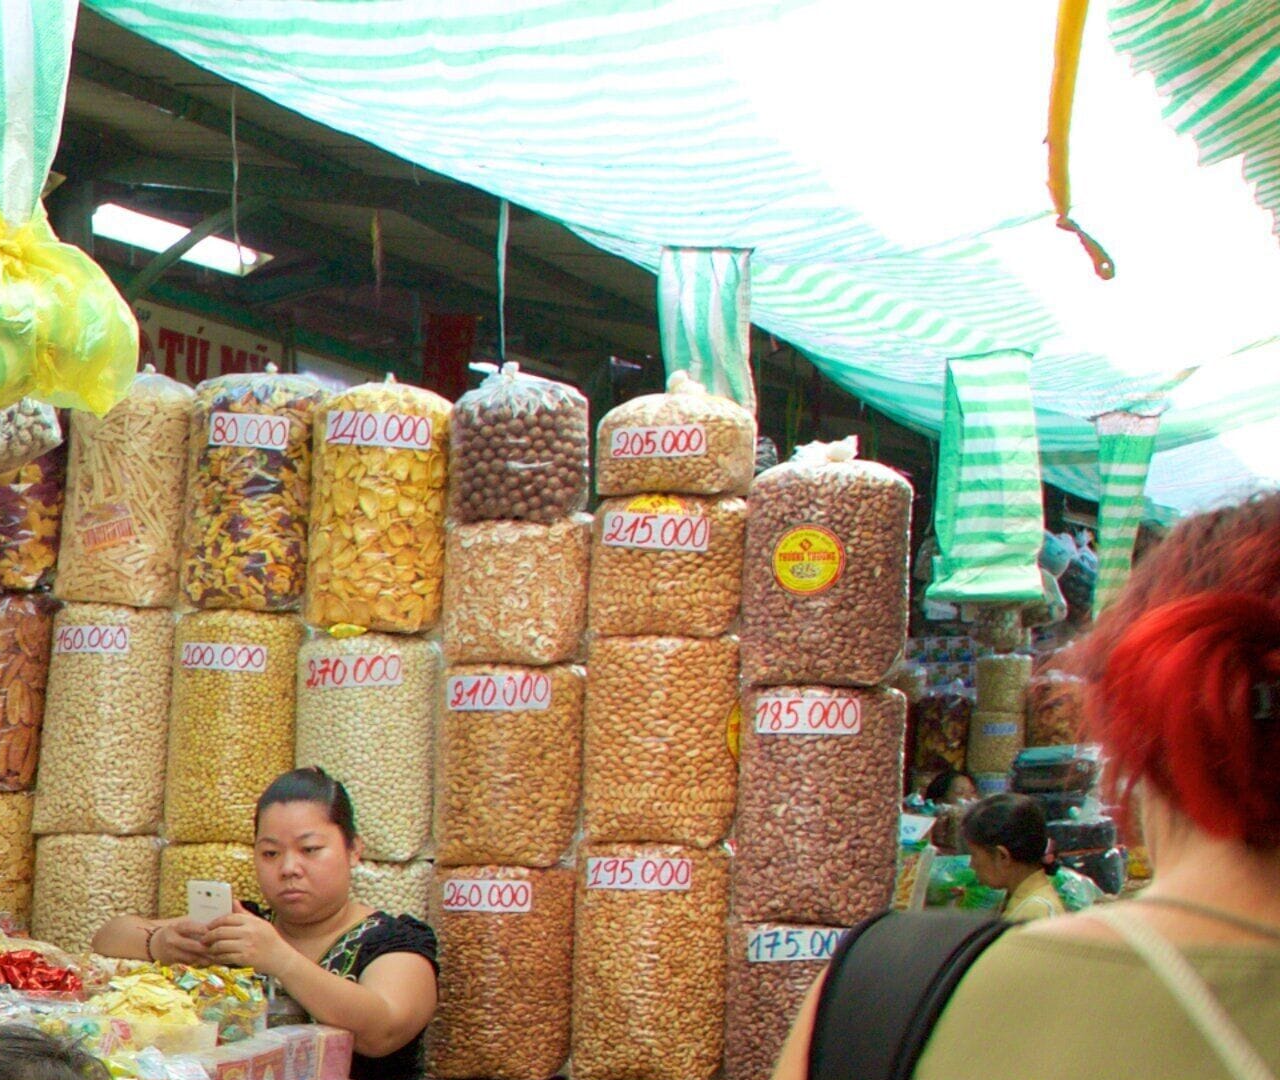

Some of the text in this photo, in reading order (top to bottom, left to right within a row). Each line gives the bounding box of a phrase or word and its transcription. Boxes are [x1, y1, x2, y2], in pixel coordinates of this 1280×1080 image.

[612, 427, 704, 457] 205.000
[605, 513, 709, 549] 215.000
[57, 626, 129, 653] 160.000
[181, 644, 265, 669] 200.000
[756, 698, 858, 731] 185.000
[589, 858, 691, 886] 195.000
